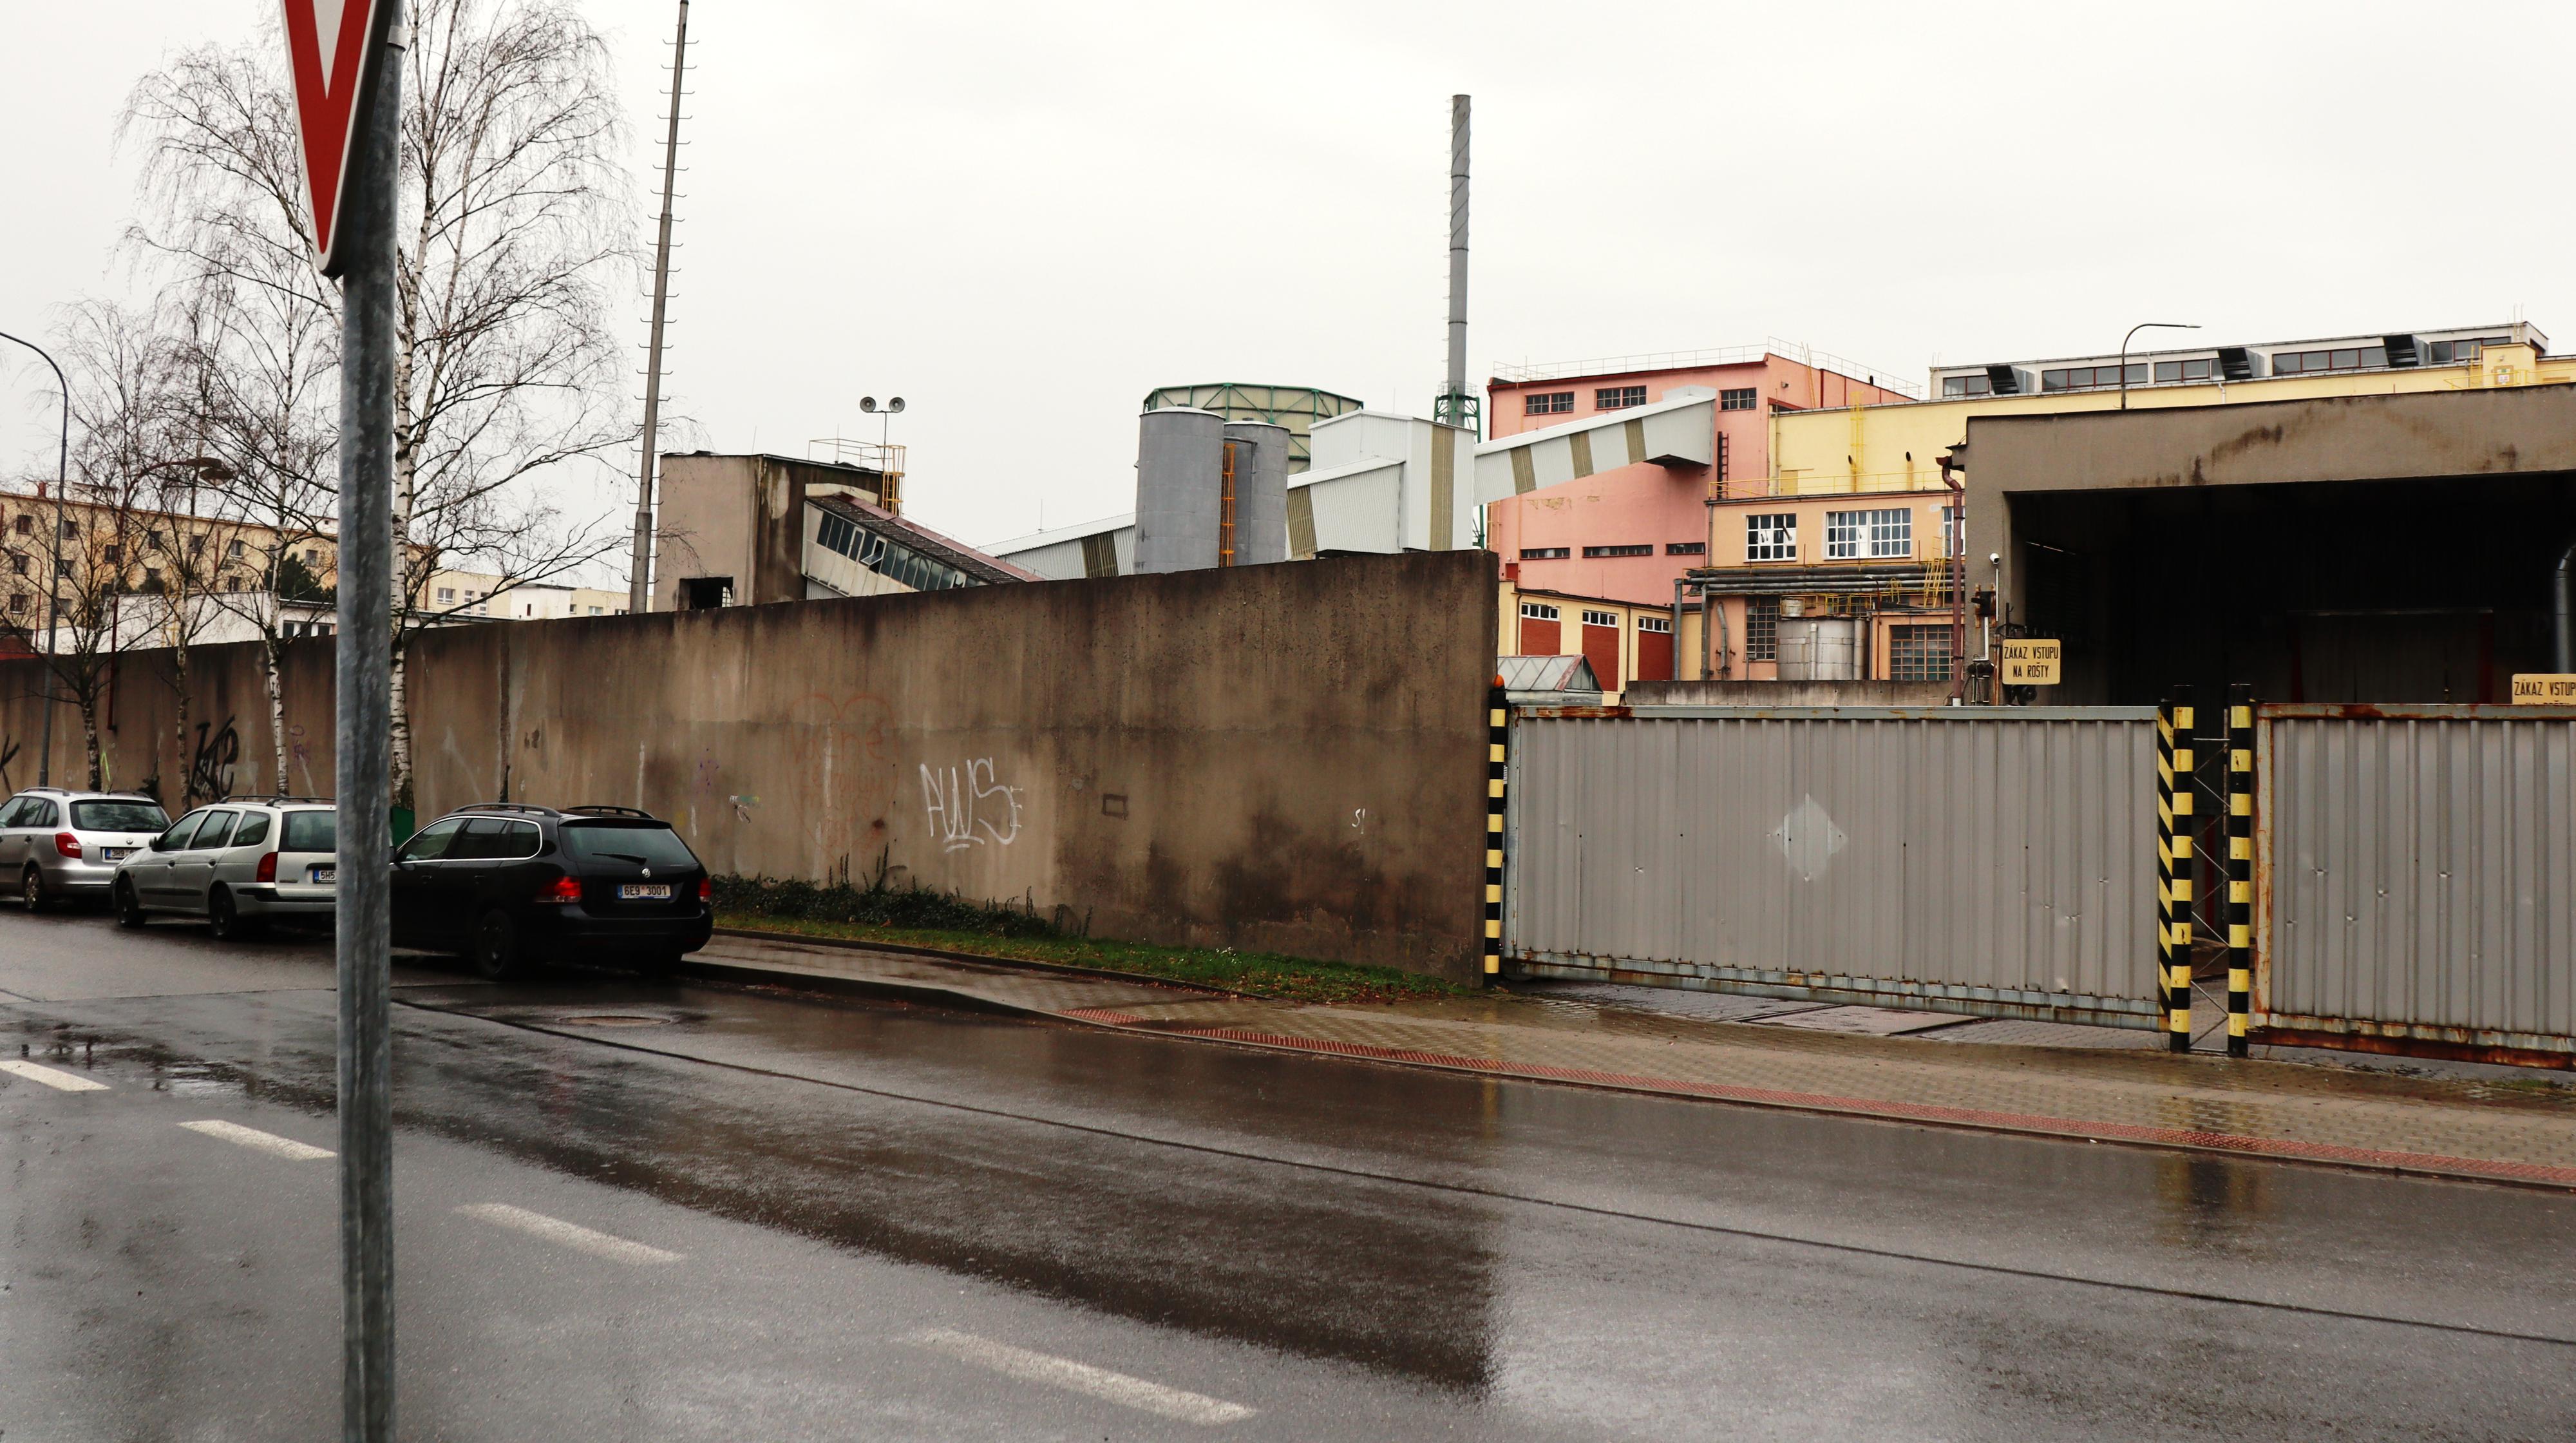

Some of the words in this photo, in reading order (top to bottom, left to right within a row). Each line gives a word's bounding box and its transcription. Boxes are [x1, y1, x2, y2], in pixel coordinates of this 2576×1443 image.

[2004, 644, 2028, 660] ZÁKAZ
[2032, 646, 2059, 660] VSTUPU
[2013, 665, 2022, 678] NA
[2027, 662, 2049, 678] ROŠTY
[2514, 679, 2543, 696] ZÁKAZ
[321, 871, 336, 879] 5H5
[624, 886, 640, 895] 6E9
[646, 886, 667, 895] 3001
